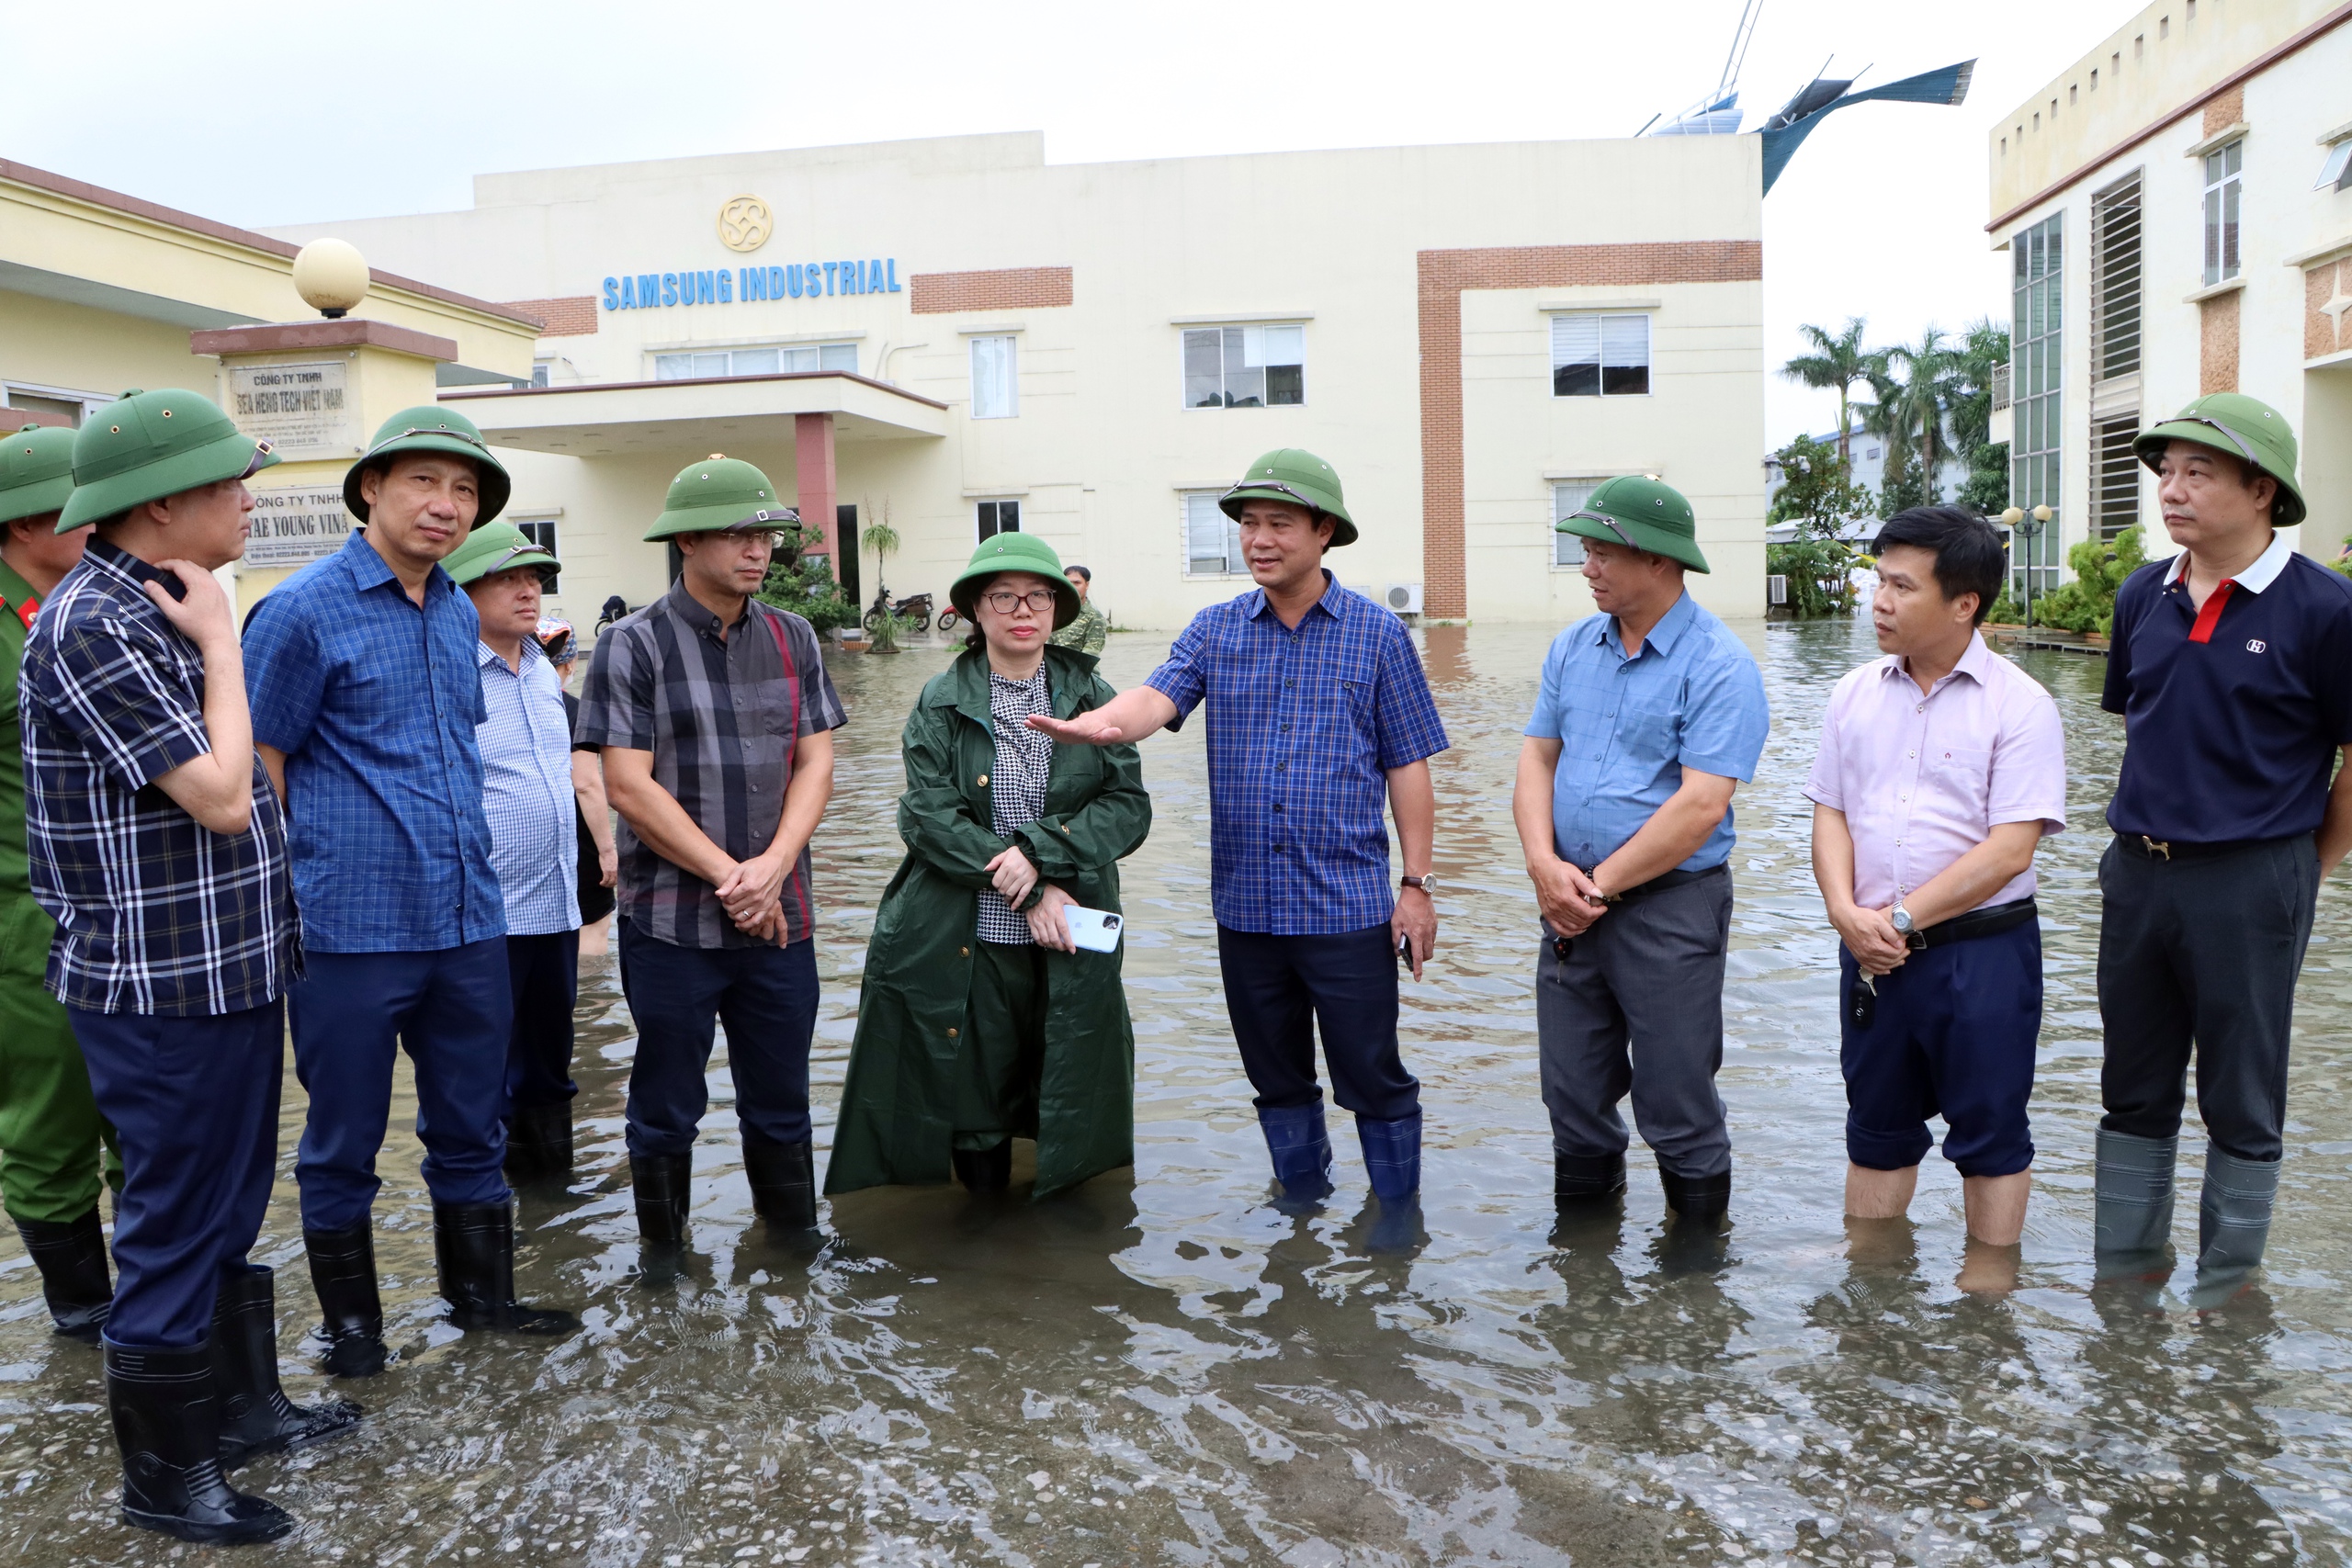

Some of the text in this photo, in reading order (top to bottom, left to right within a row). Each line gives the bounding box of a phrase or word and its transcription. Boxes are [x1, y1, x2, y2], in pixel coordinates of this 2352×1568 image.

[603, 258, 901, 310] SAMSUNG INDUSTRIAL
[254, 372, 322, 386] CÔNG TY TNHH
[255, 392, 278, 414] HENG
[255, 494, 344, 508] ÔNG TY TNHH
[273, 515, 314, 536] YOUNG
[319, 513, 349, 535] VINA
